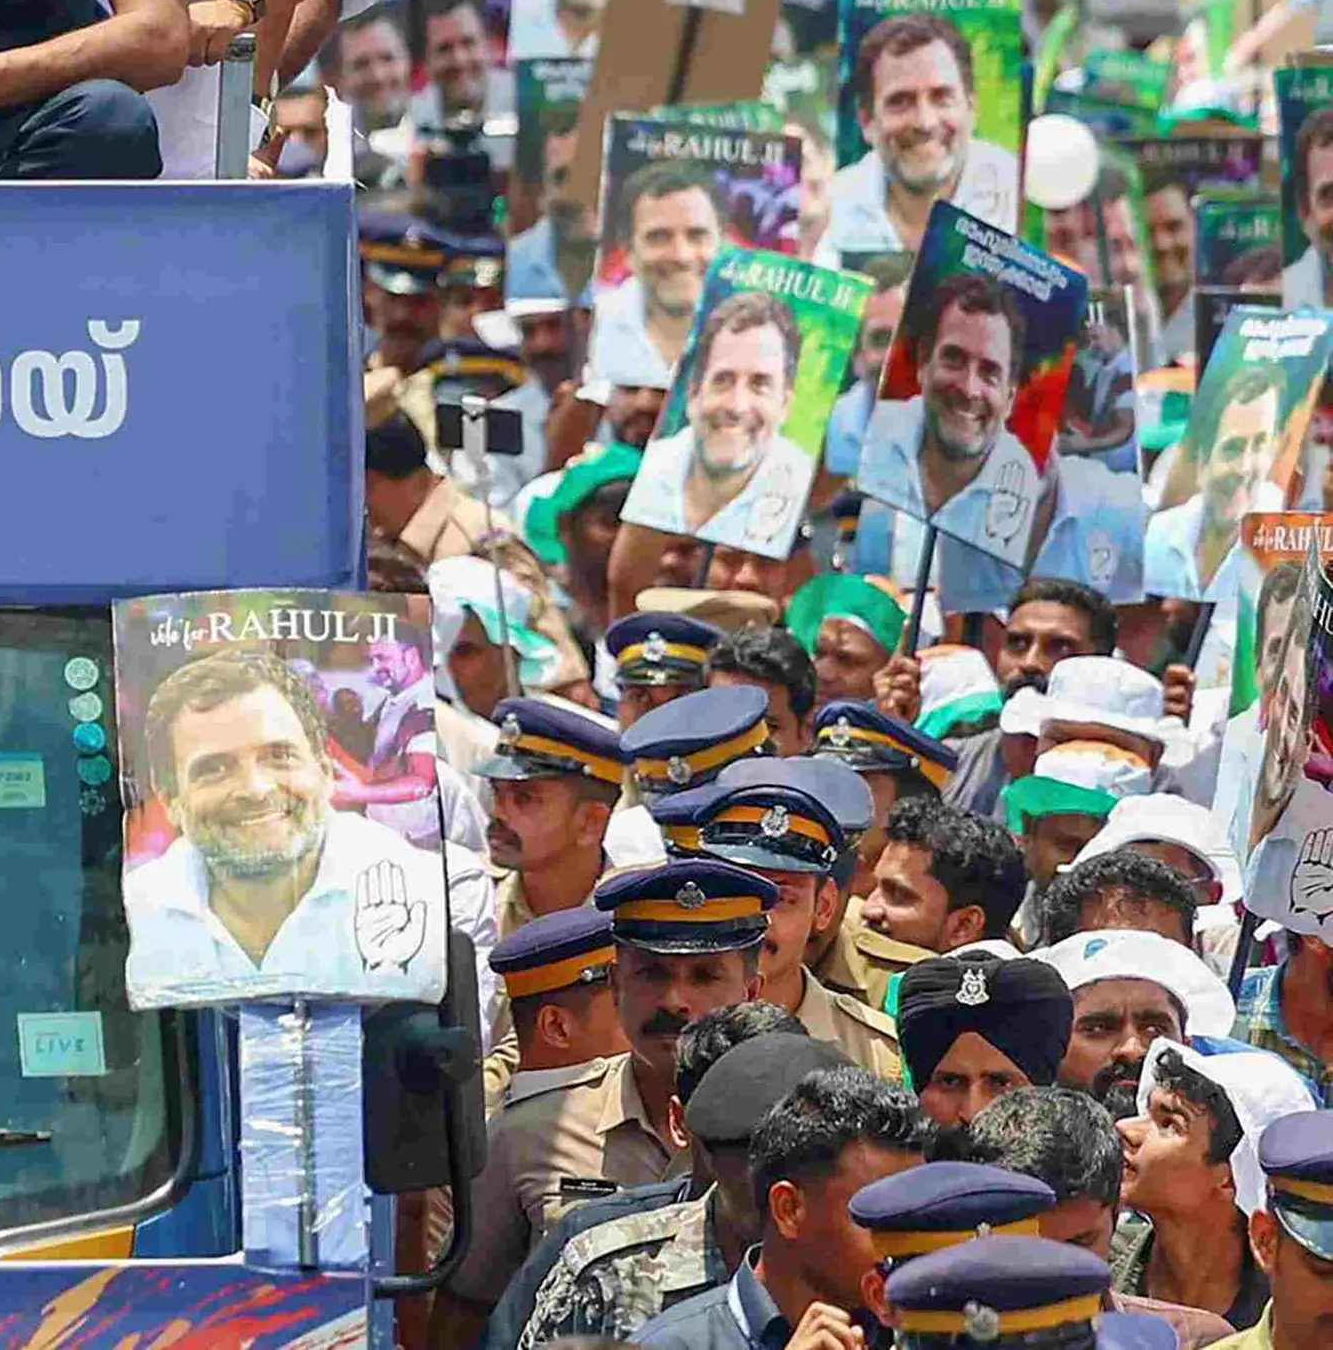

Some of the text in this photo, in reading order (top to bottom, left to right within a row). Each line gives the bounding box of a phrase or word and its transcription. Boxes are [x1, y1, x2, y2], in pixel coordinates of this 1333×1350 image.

[664, 131, 759, 165] RAHUL
[760, 140, 785, 166] JI
[748, 260, 827, 305] RAHUL
[830, 281, 856, 312] JI
[207, 608, 360, 645] RAHUL
[365, 610, 398, 646] JI
